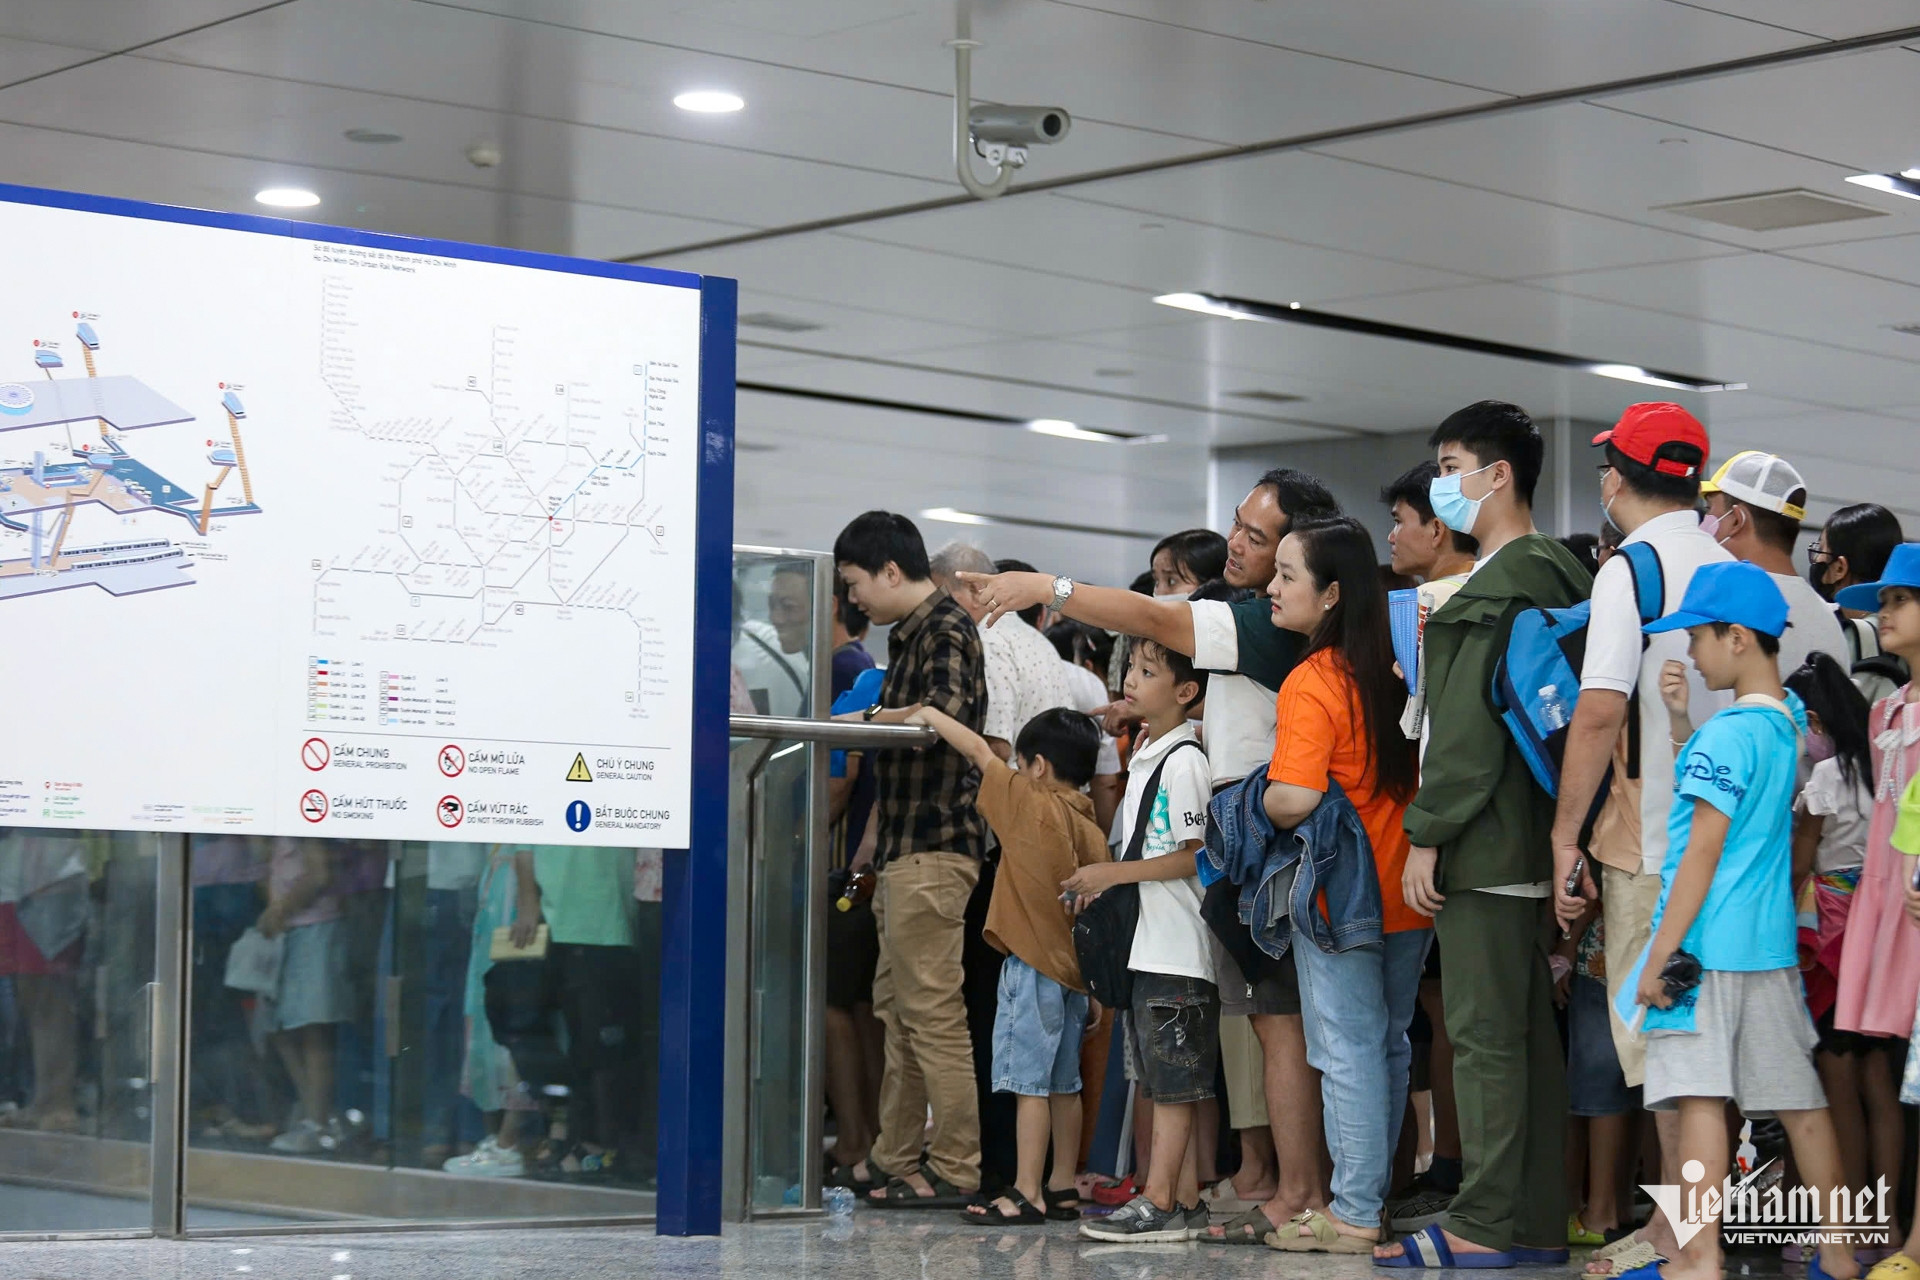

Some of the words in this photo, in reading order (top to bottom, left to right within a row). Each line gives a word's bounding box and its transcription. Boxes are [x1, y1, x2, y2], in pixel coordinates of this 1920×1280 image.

[334, 743, 354, 756] CẤM
[357, 747, 390, 758] CHUNG
[468, 750, 488, 763] CẤM
[334, 760, 364, 768] GENERAL
[366, 761, 407, 770] PROHIBITION
[624, 760, 654, 771] CHUNG
[498, 767, 520, 775] FLAME
[596, 772, 624, 780] GENERAL
[626, 773, 652, 781] CAUTION
[332, 794, 352, 808] CẤM
[467, 800, 487, 813] CẤM
[640, 809, 670, 820] CHUNG
[516, 818, 544, 826] RUBBISH
[595, 821, 624, 829] GENERAL
[625, 822, 662, 830] MANDATORY
